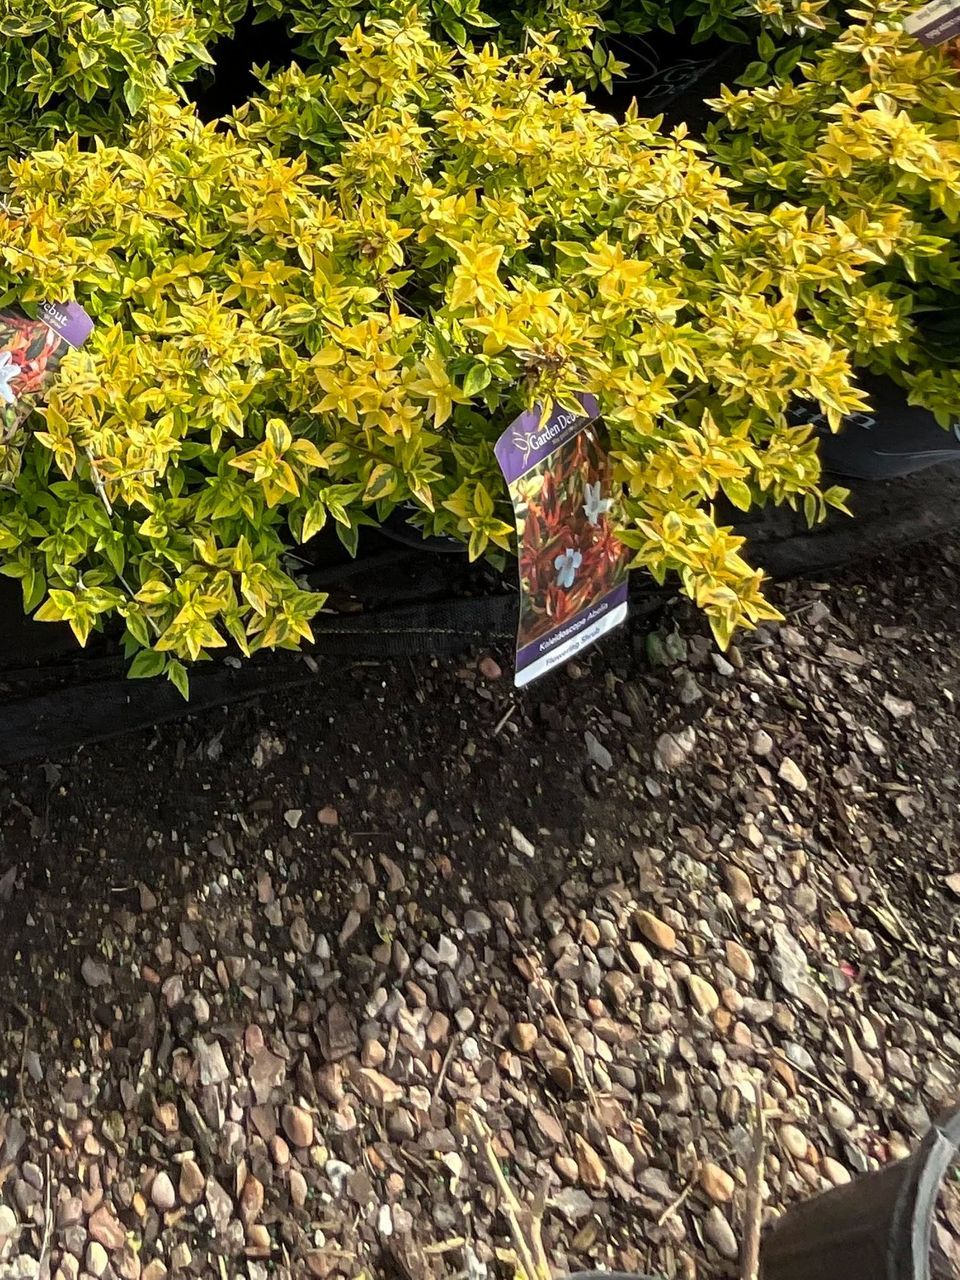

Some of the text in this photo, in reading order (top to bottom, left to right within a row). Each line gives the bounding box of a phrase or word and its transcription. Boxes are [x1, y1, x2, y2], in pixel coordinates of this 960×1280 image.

[529, 424, 561, 451] Garden
[557, 411, 577, 430] Deb
[539, 603, 609, 652] Kaleidoscope Abelia
